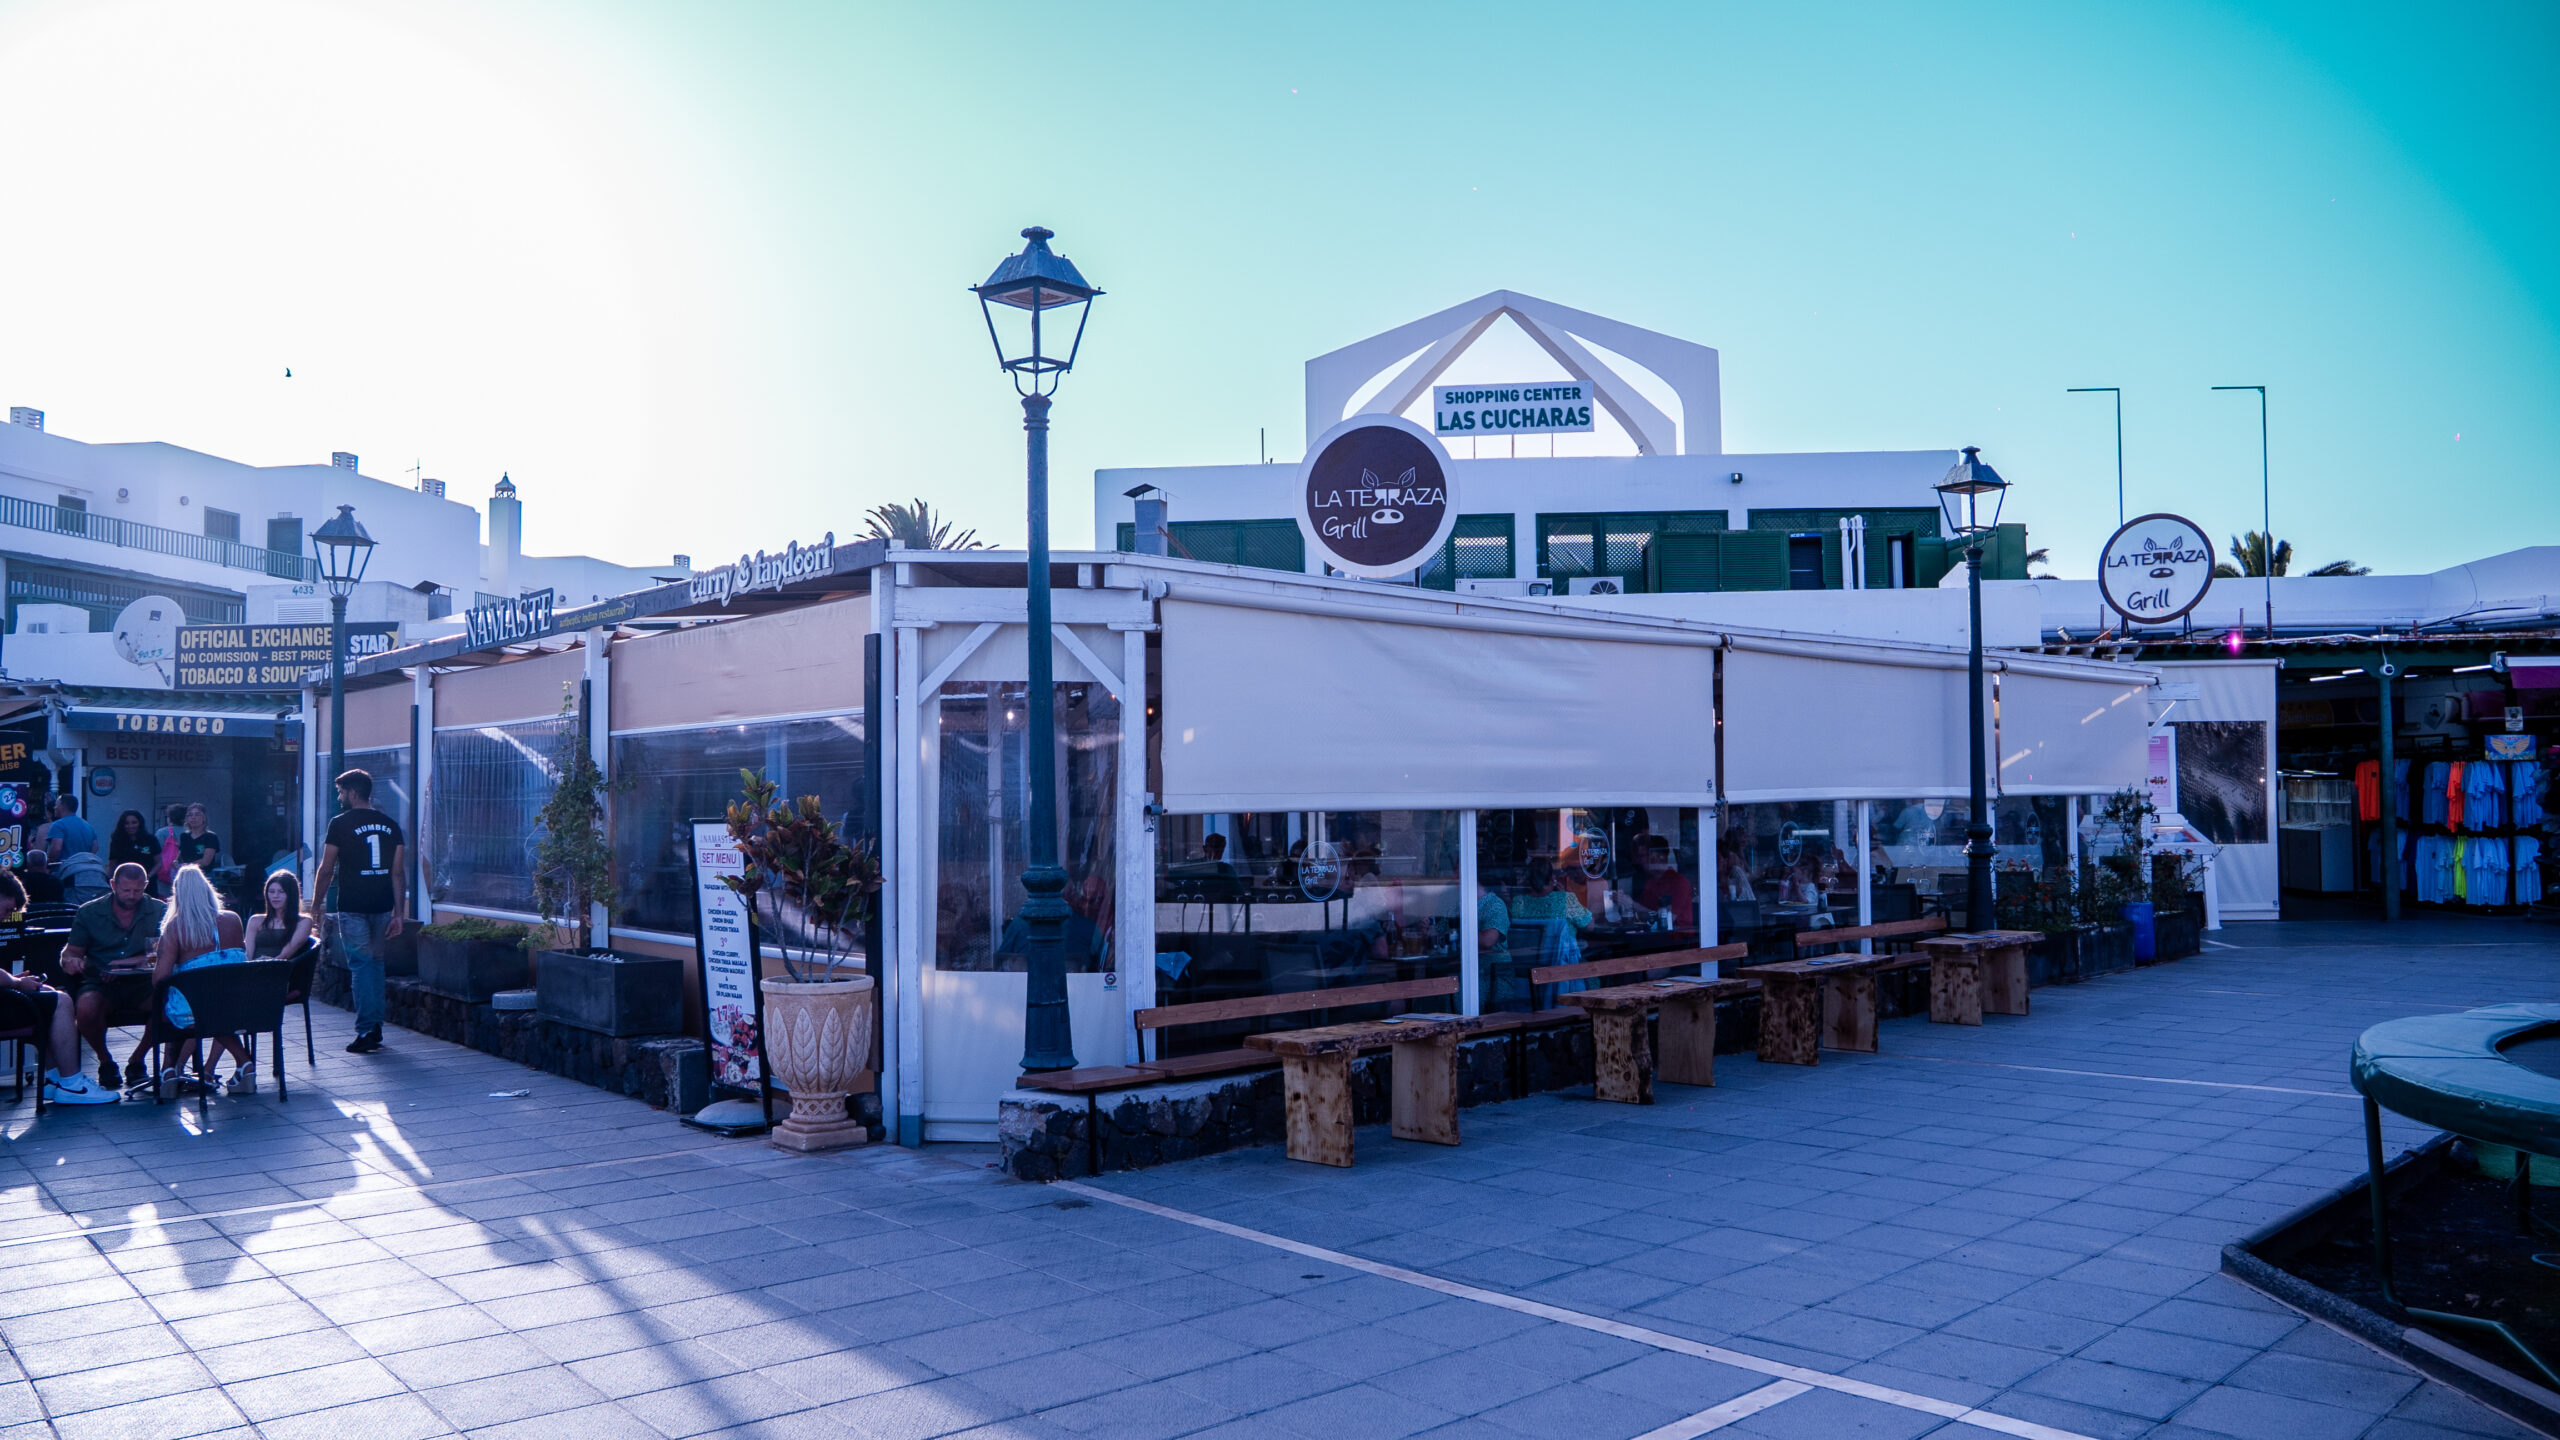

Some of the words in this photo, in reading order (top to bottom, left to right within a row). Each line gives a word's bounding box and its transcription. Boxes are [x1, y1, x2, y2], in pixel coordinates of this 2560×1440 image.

[1445, 389, 1520, 405] SHOPPING
[1523, 386, 1581, 402] CENTER
[1437, 409, 1476, 431] LAS
[1480, 406, 1591, 429] CUCHARAS
[1314, 489, 1343, 508] LA
[1345, 487, 1447, 508] TERRAZA
[1322, 516, 1368, 539] Grill
[737, 557, 751, 588] &
[754, 534, 834, 592] tandoori
[2107, 554, 2129, 568] LA
[2130, 549, 2208, 566] TERRAZA
[2127, 588, 2171, 611] Grill
[465, 591, 552, 648] NAMASTE
[180, 629, 247, 649] OFFICIAL
[251, 627, 333, 648] EXCHANGE
[350, 634, 389, 654] STAR
[180, 653, 197, 664] NO
[199, 651, 259, 663] COMISSION
[271, 650, 298, 662] BEST
[180, 667, 244, 685] TOBACCO
[247, 666, 257, 684] &
[261, 664, 311, 684] SOUVE
[116, 714, 225, 735] TOBACCO
[0, 742, 27, 761] ER
[105, 746, 152, 761] BEST
[156, 748, 215, 762] PRICES
[354, 823, 393, 836] NUMBER
[367, 834, 381, 868] 1
[702, 852, 715, 864] SET
[716, 852, 737, 864] MENU
[1301, 865, 1310, 875] LA
